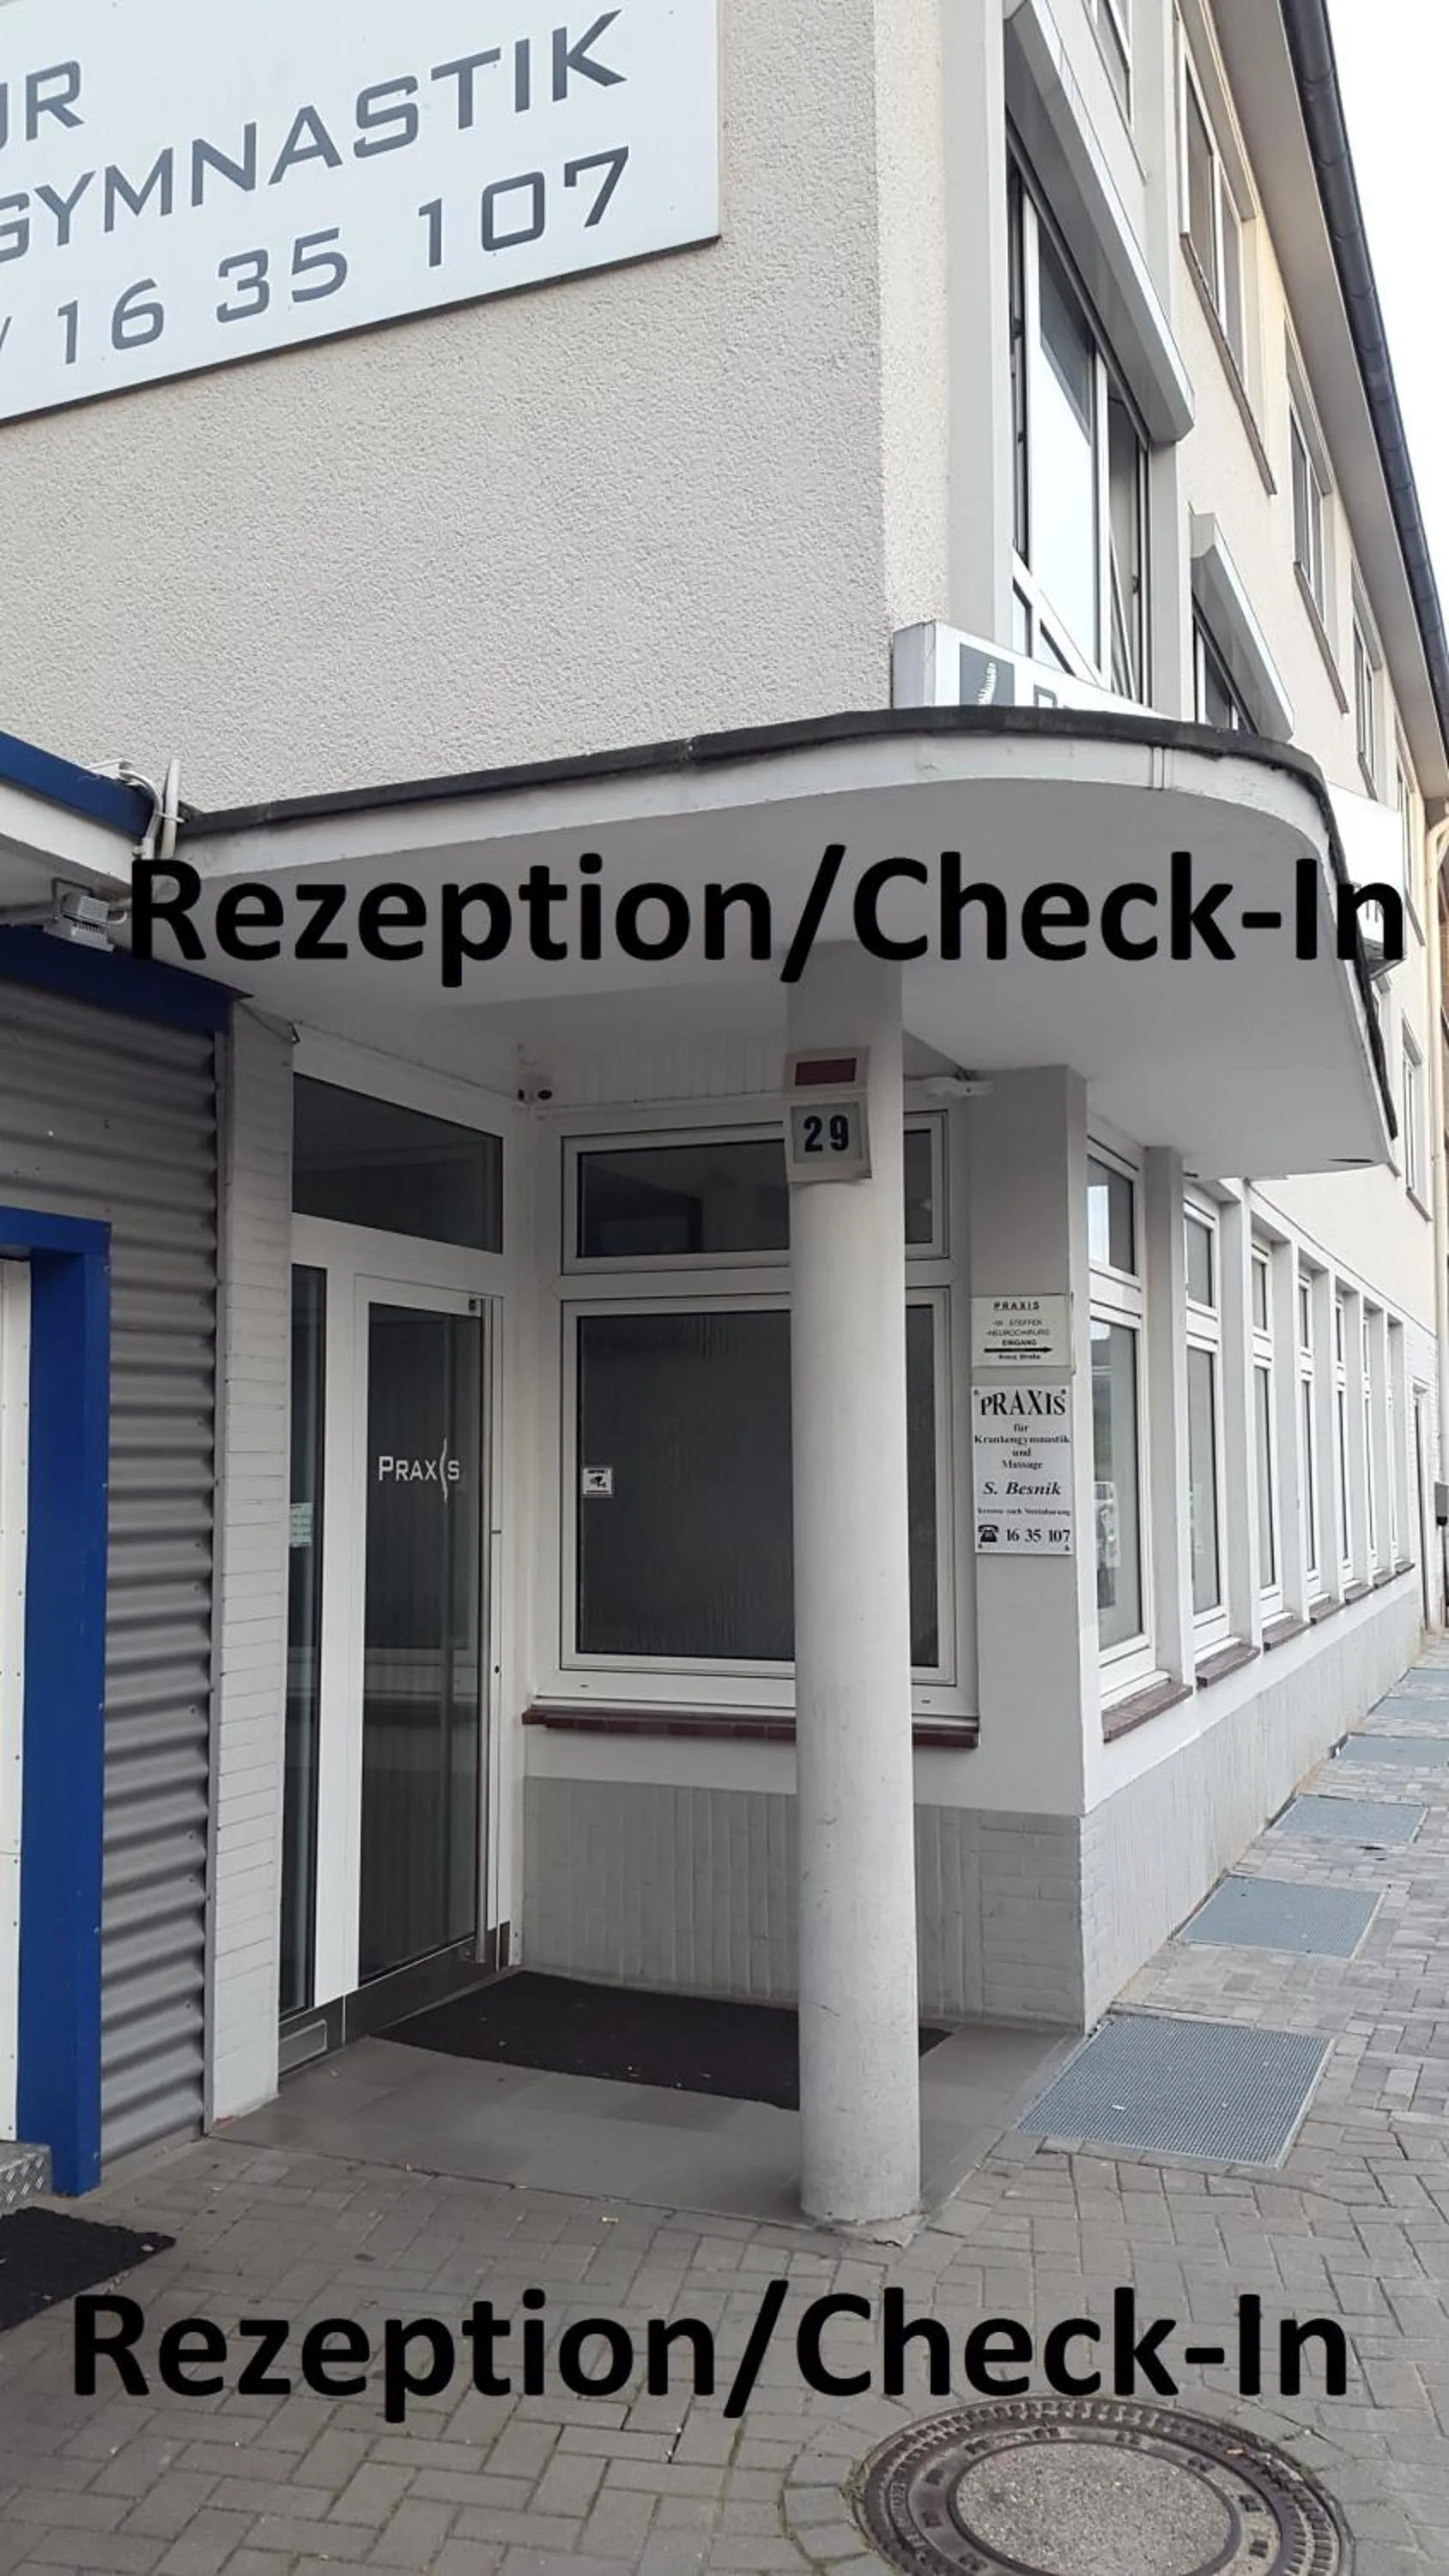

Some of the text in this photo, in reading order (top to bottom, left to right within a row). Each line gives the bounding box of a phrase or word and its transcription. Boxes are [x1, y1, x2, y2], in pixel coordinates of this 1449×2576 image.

[58, 277, 165, 365] 16
[215, 227, 348, 325] 35
[418, 146, 629, 268] 107
[803, 1114, 849, 1152] 29
[993, 1301, 1040, 1310] PRAXIS
[979, 1388, 1066, 1416] PRAXIS
[1012, 1447, 1031, 1456] und
[982, 1481, 1061, 1495] S. Besnik
[1006, 1528, 1070, 1543] 16 35 107
